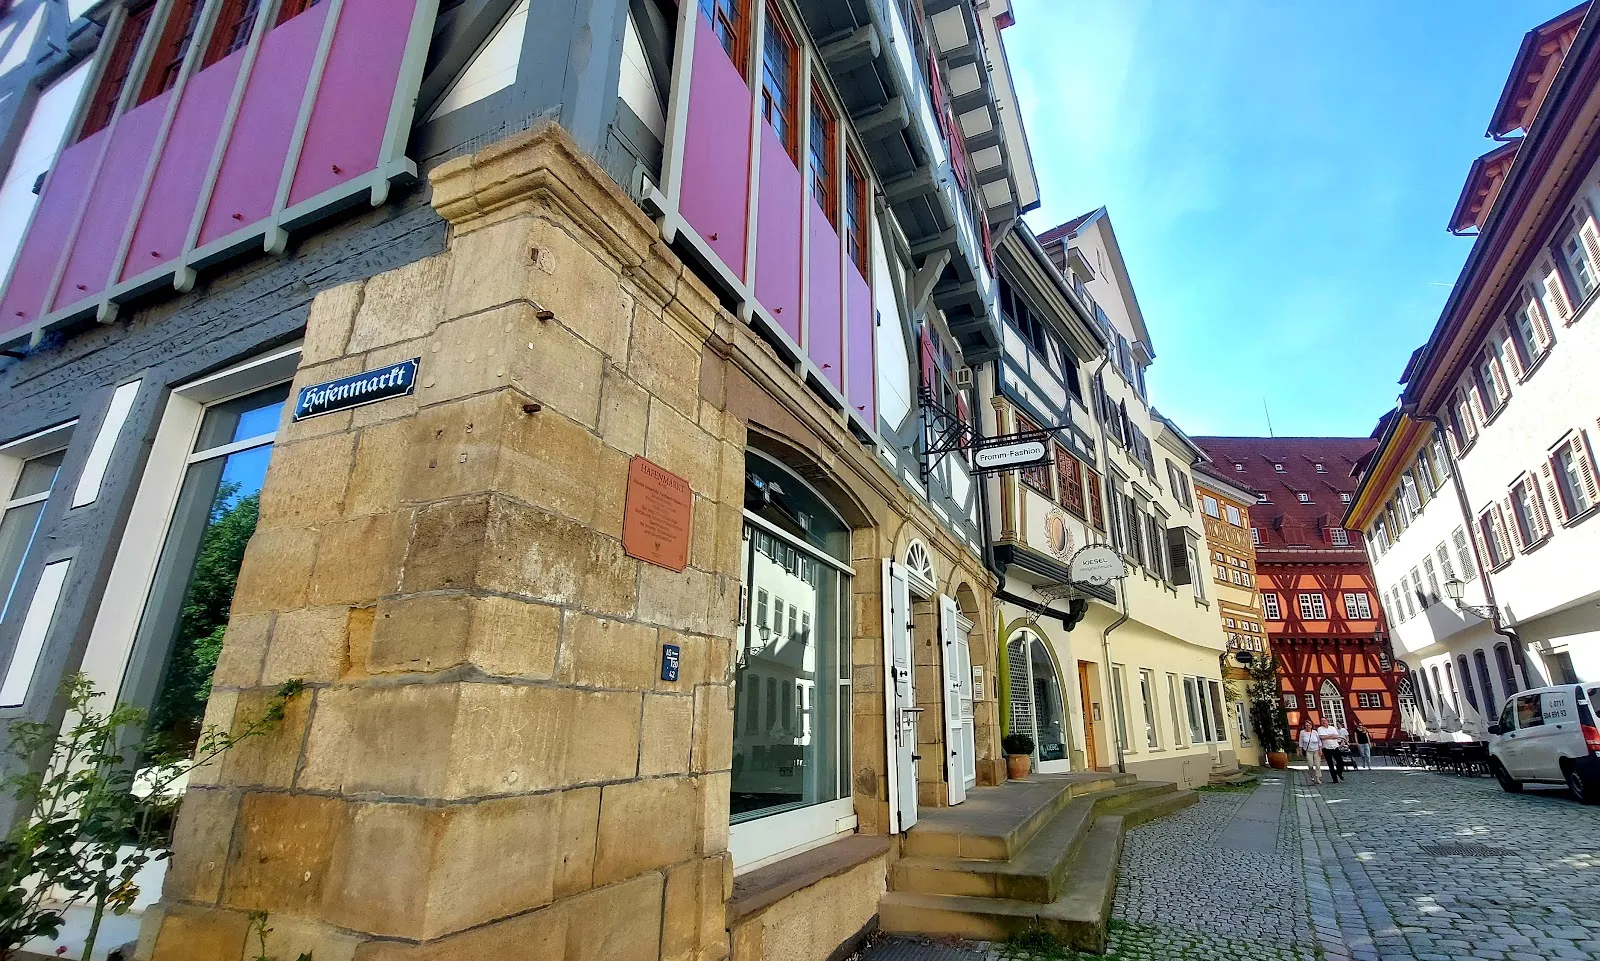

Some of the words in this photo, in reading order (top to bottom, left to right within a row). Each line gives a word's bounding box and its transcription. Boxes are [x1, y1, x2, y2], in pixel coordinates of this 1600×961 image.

[302, 366, 405, 412] Hafenmarkt
[980, 447, 1040, 461] Fromm-Fashion
[641, 464, 685, 492] HAFENMARKT
[1083, 558, 1108, 566] KIESEL
